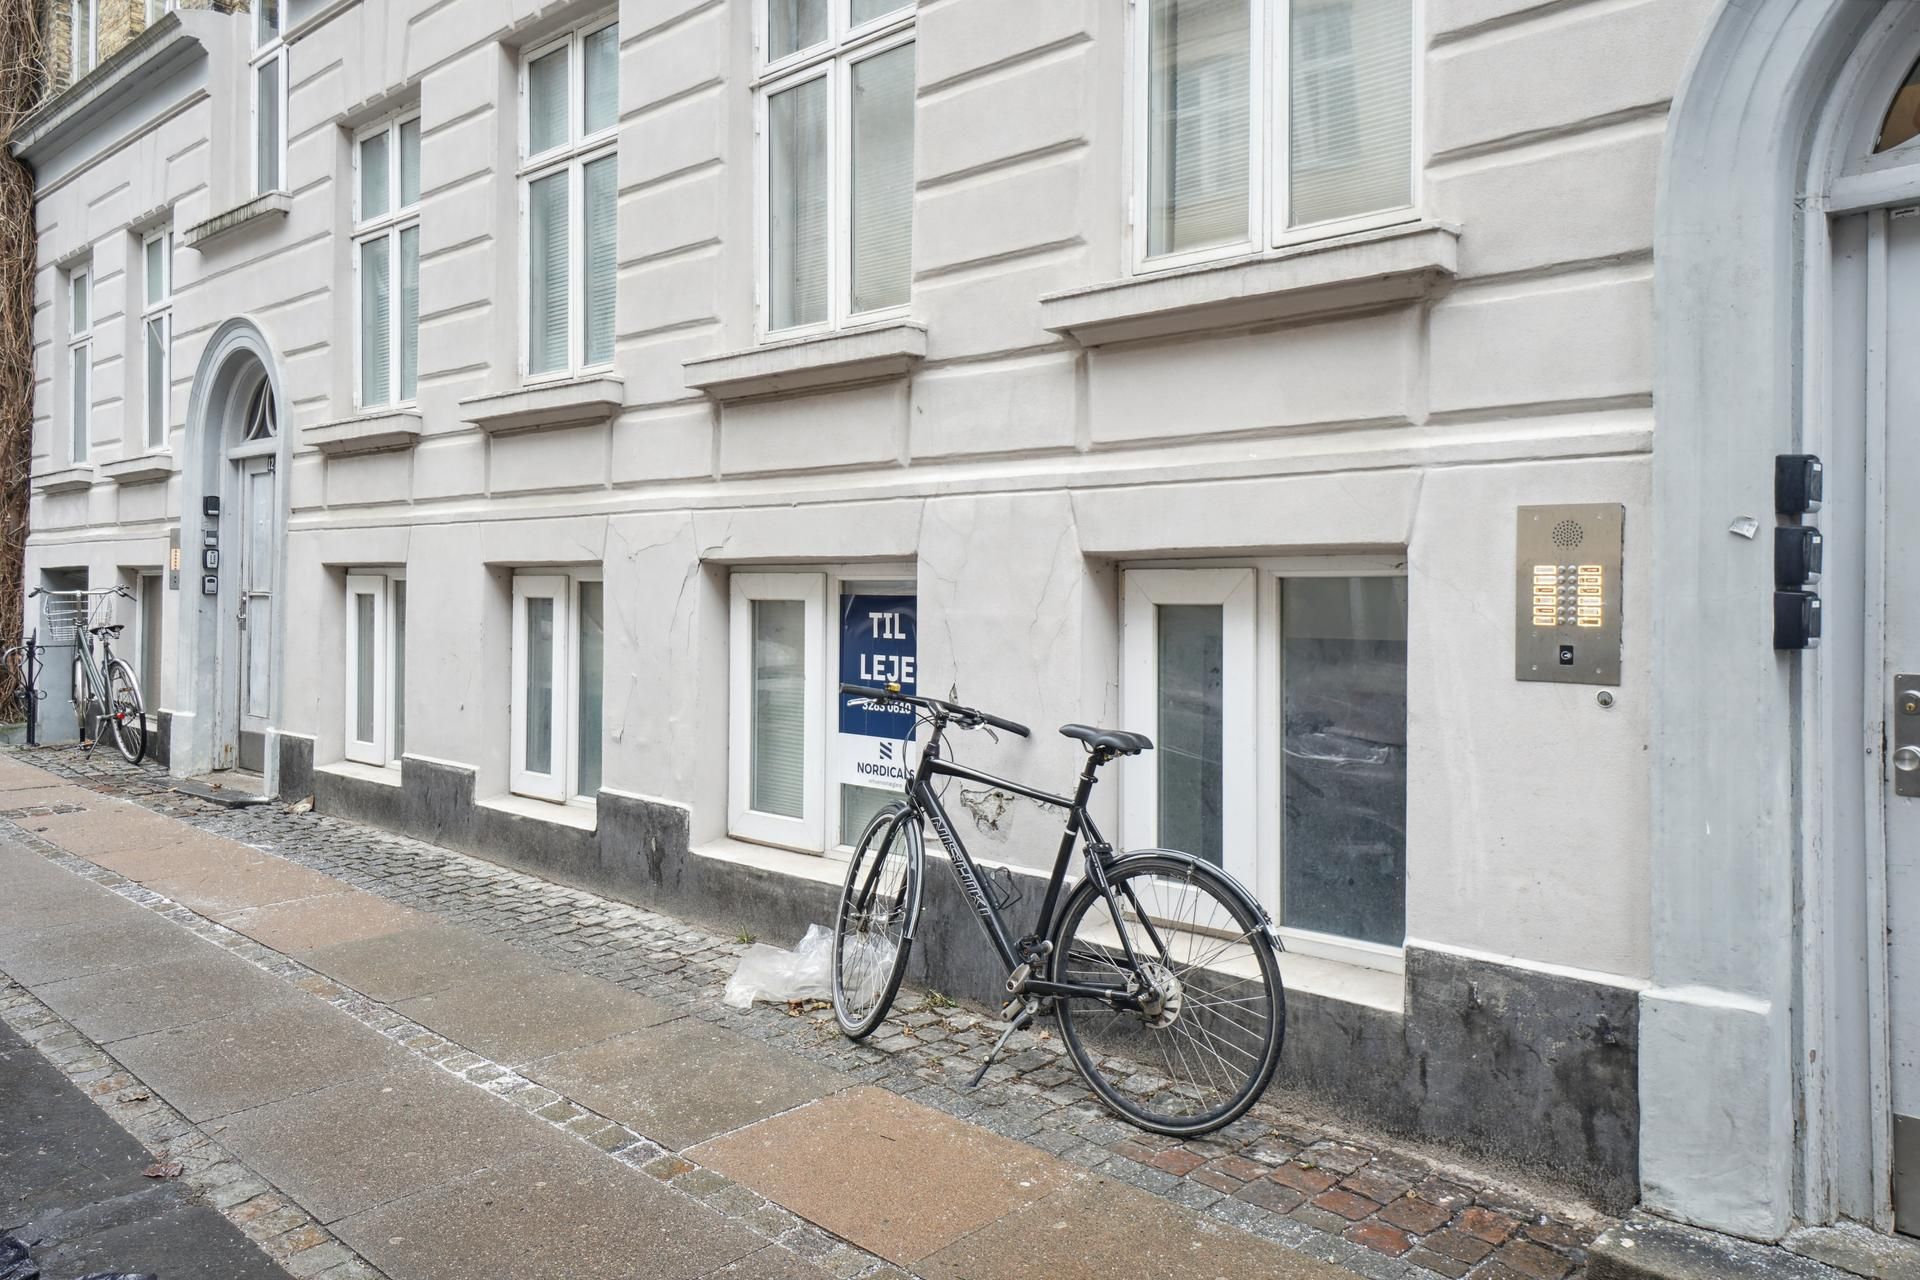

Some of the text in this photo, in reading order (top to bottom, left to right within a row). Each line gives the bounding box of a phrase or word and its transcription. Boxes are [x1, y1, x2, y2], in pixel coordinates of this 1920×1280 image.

[869, 612, 906, 639] TIL
[860, 653, 915, 684] LEJE
[857, 761, 915, 780] NORDICALS
